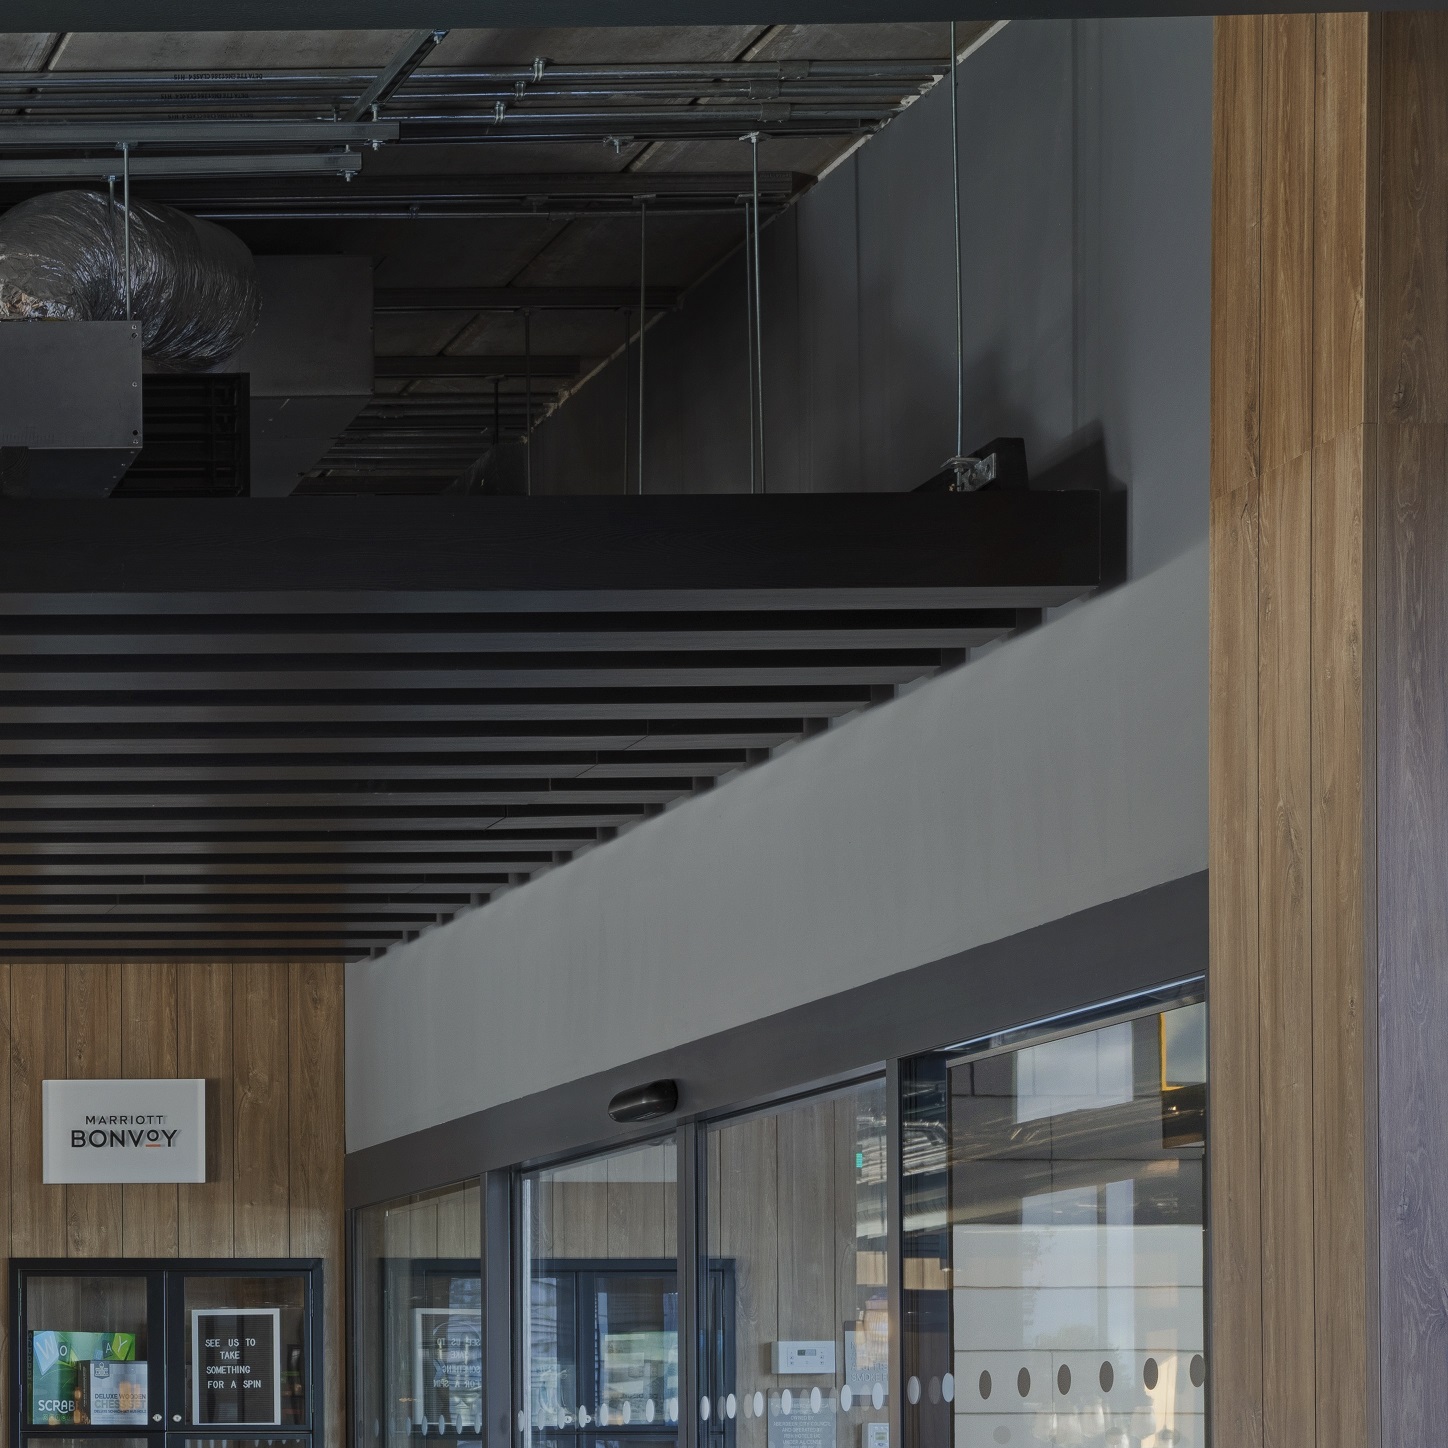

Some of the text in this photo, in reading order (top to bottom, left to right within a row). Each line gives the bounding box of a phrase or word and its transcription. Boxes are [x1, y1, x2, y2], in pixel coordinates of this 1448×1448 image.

[85, 1115, 163, 1125] MARRIOTT
[71, 1129, 178, 1148] BONVOY
[205, 1338, 256, 1348] SEE US TO
[220, 1351, 240, 1360] TAKE
[206, 1365, 251, 1375] SOMETHING
[207, 1380, 262, 1389] FOR A SPIN
[37, 1399, 76, 1413] SCRAB
